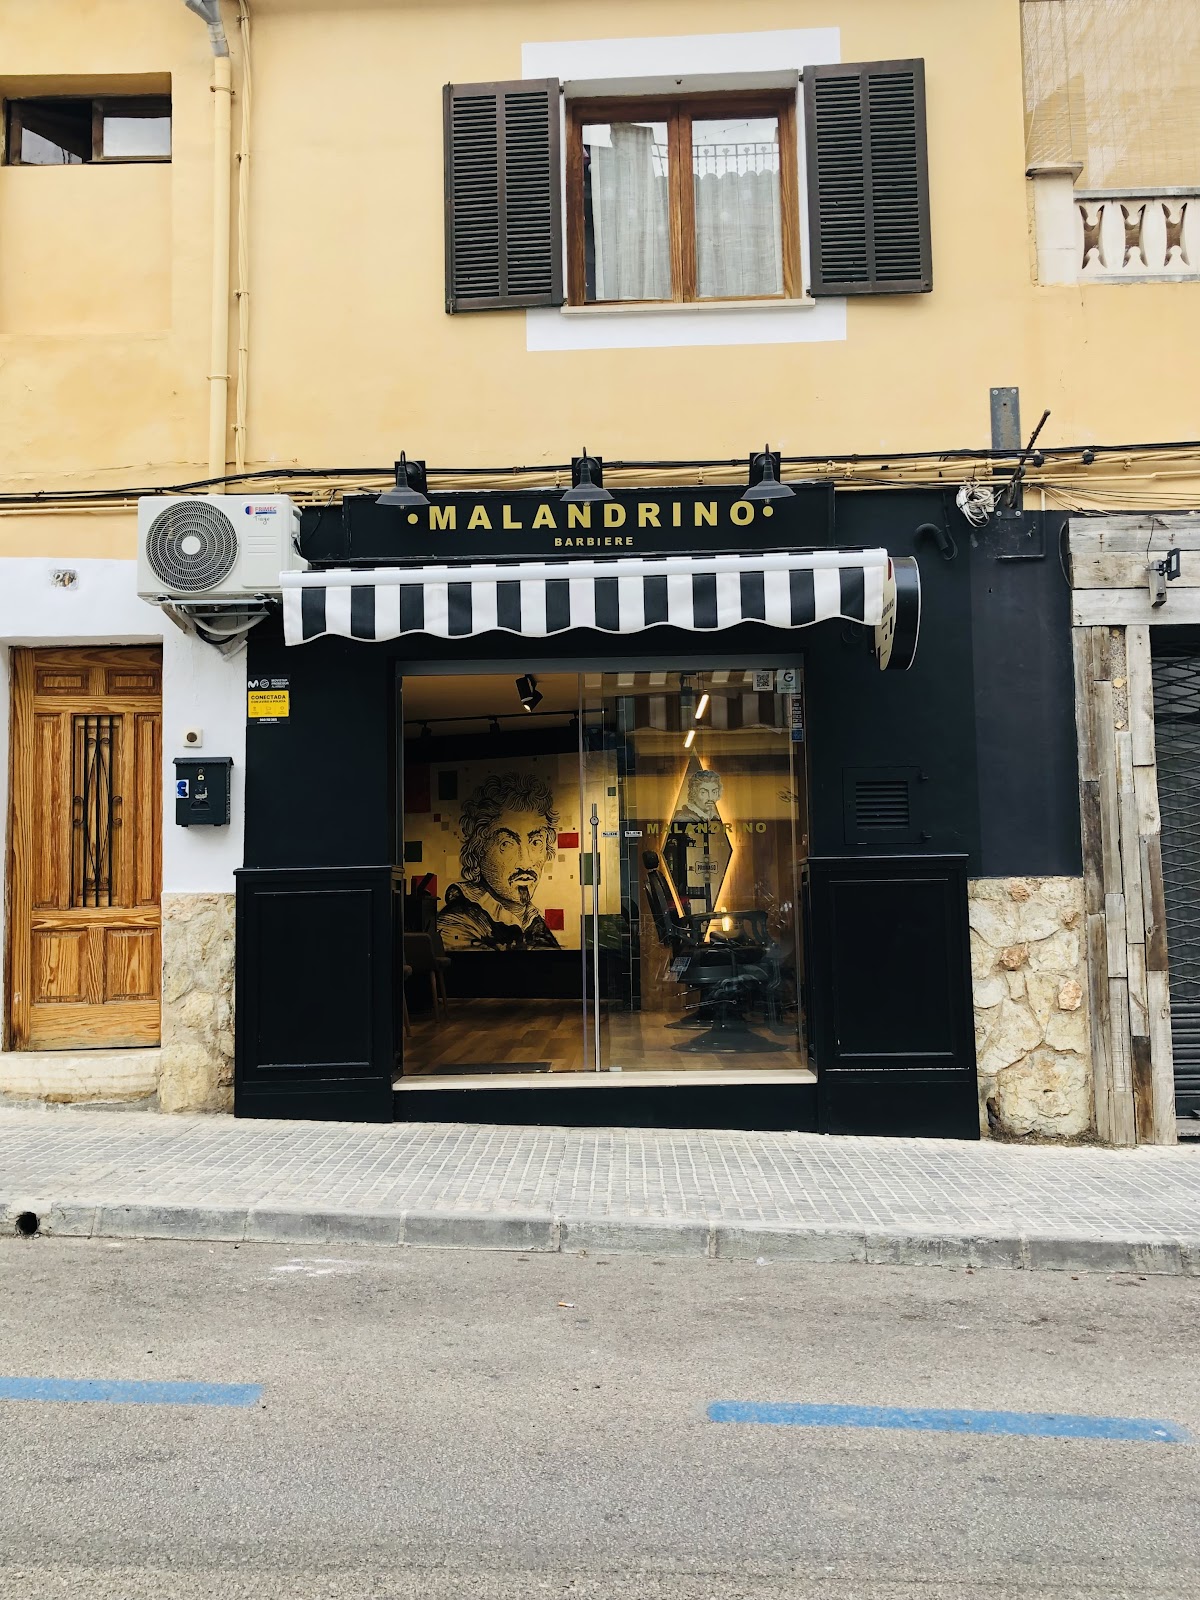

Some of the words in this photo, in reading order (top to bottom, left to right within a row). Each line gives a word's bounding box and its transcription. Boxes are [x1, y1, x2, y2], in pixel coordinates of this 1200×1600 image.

[429, 501, 755, 530] MALANDRINO
[554, 536, 634, 547] BARBIERE
[646, 822, 767, 834] MALANDRNO
